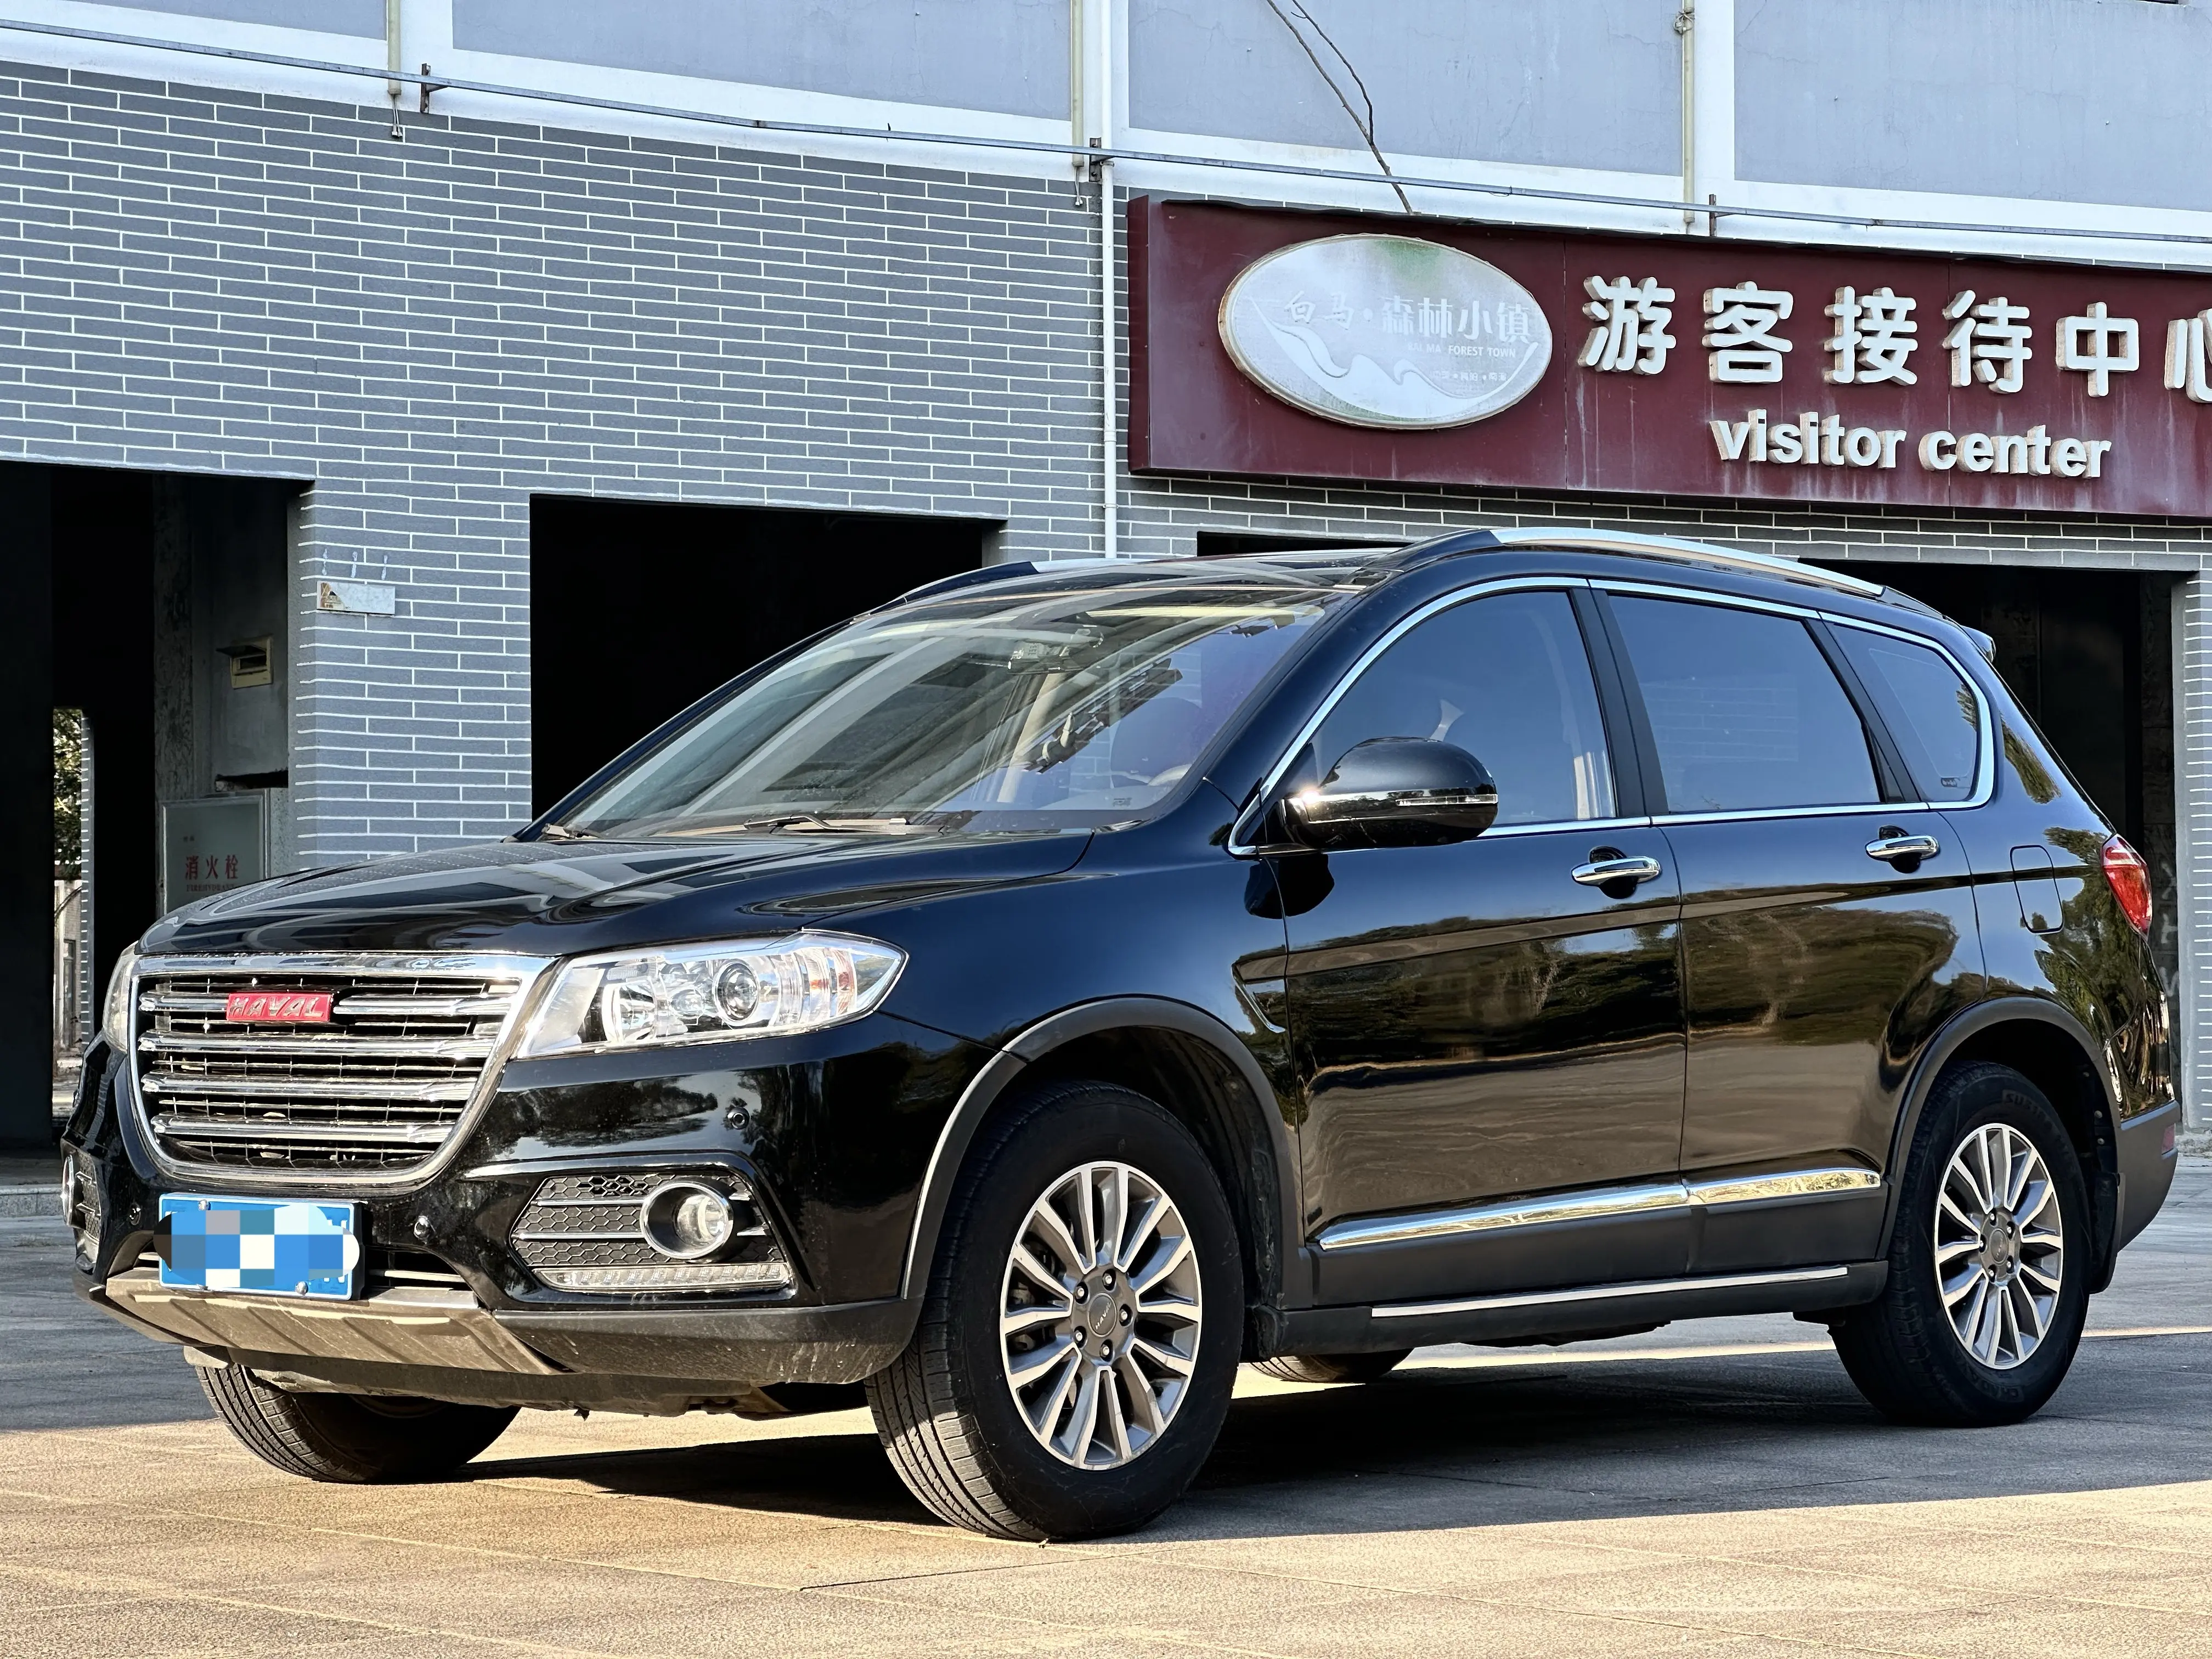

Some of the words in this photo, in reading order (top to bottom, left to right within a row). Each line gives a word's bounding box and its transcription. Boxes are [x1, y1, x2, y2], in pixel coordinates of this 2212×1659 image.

[1426, 344, 1441, 353] MA
[1448, 345, 1483, 356] FOREST
[1487, 347, 1516, 357] TOWN
[1709, 409, 1906, 468] visitor
[1918, 425, 2111, 478] center
[185, 854, 238, 879] 消火栓
[229, 996, 324, 1017] HAVAL
